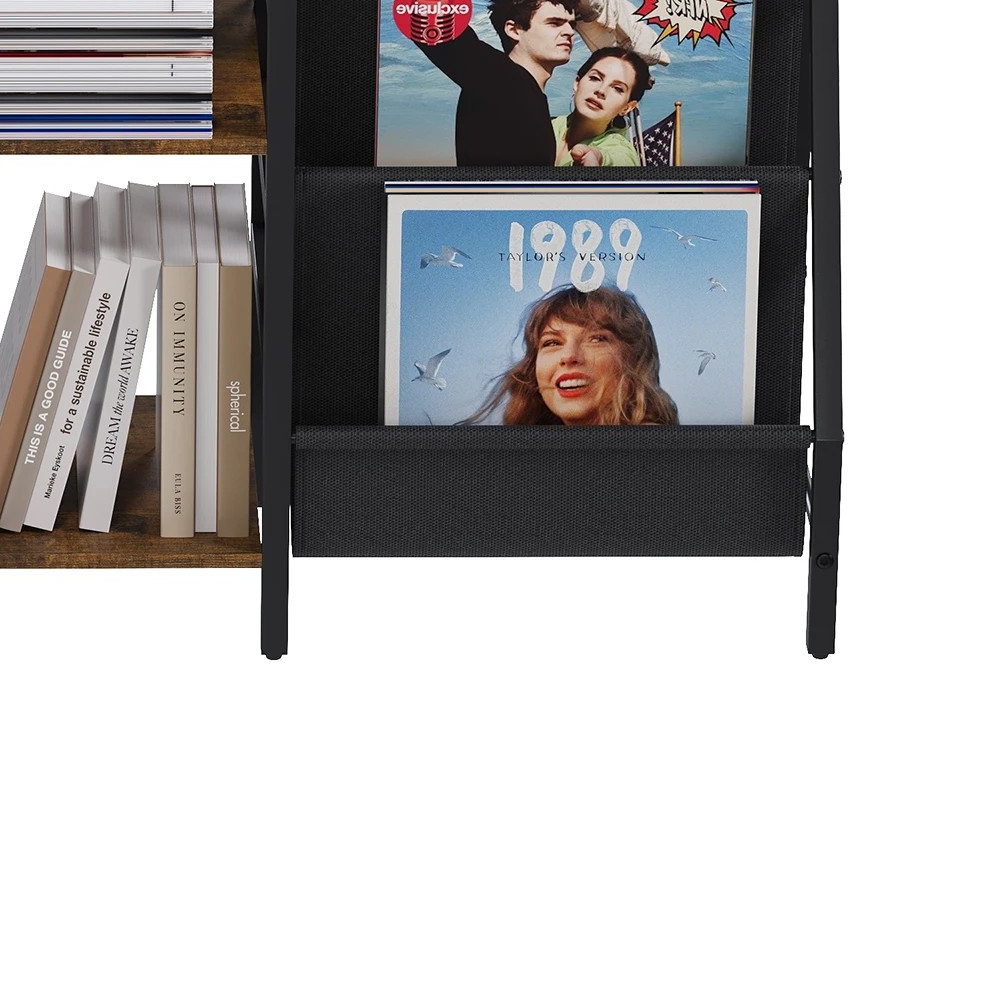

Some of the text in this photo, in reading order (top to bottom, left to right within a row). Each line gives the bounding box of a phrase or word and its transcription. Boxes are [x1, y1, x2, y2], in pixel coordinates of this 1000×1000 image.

[498, 251, 646, 262] TAYLOR'S VERSION
[508, 218, 642, 293] 1989
[60, 418, 74, 435] for
[71, 340, 98, 406] sustainable
[89, 292, 112, 337] lifestyle
[172, 301, 186, 416] ON IMMUNITY
[24, 329, 72, 465] THIS IS A GOOD GUIDE
[102, 328, 139, 465] DREAM the world AWAKE
[226, 380, 246, 432] spherical
[44, 445, 66, 499] Marieke Eyskoot
[174, 473, 182, 515] EULA BISS
